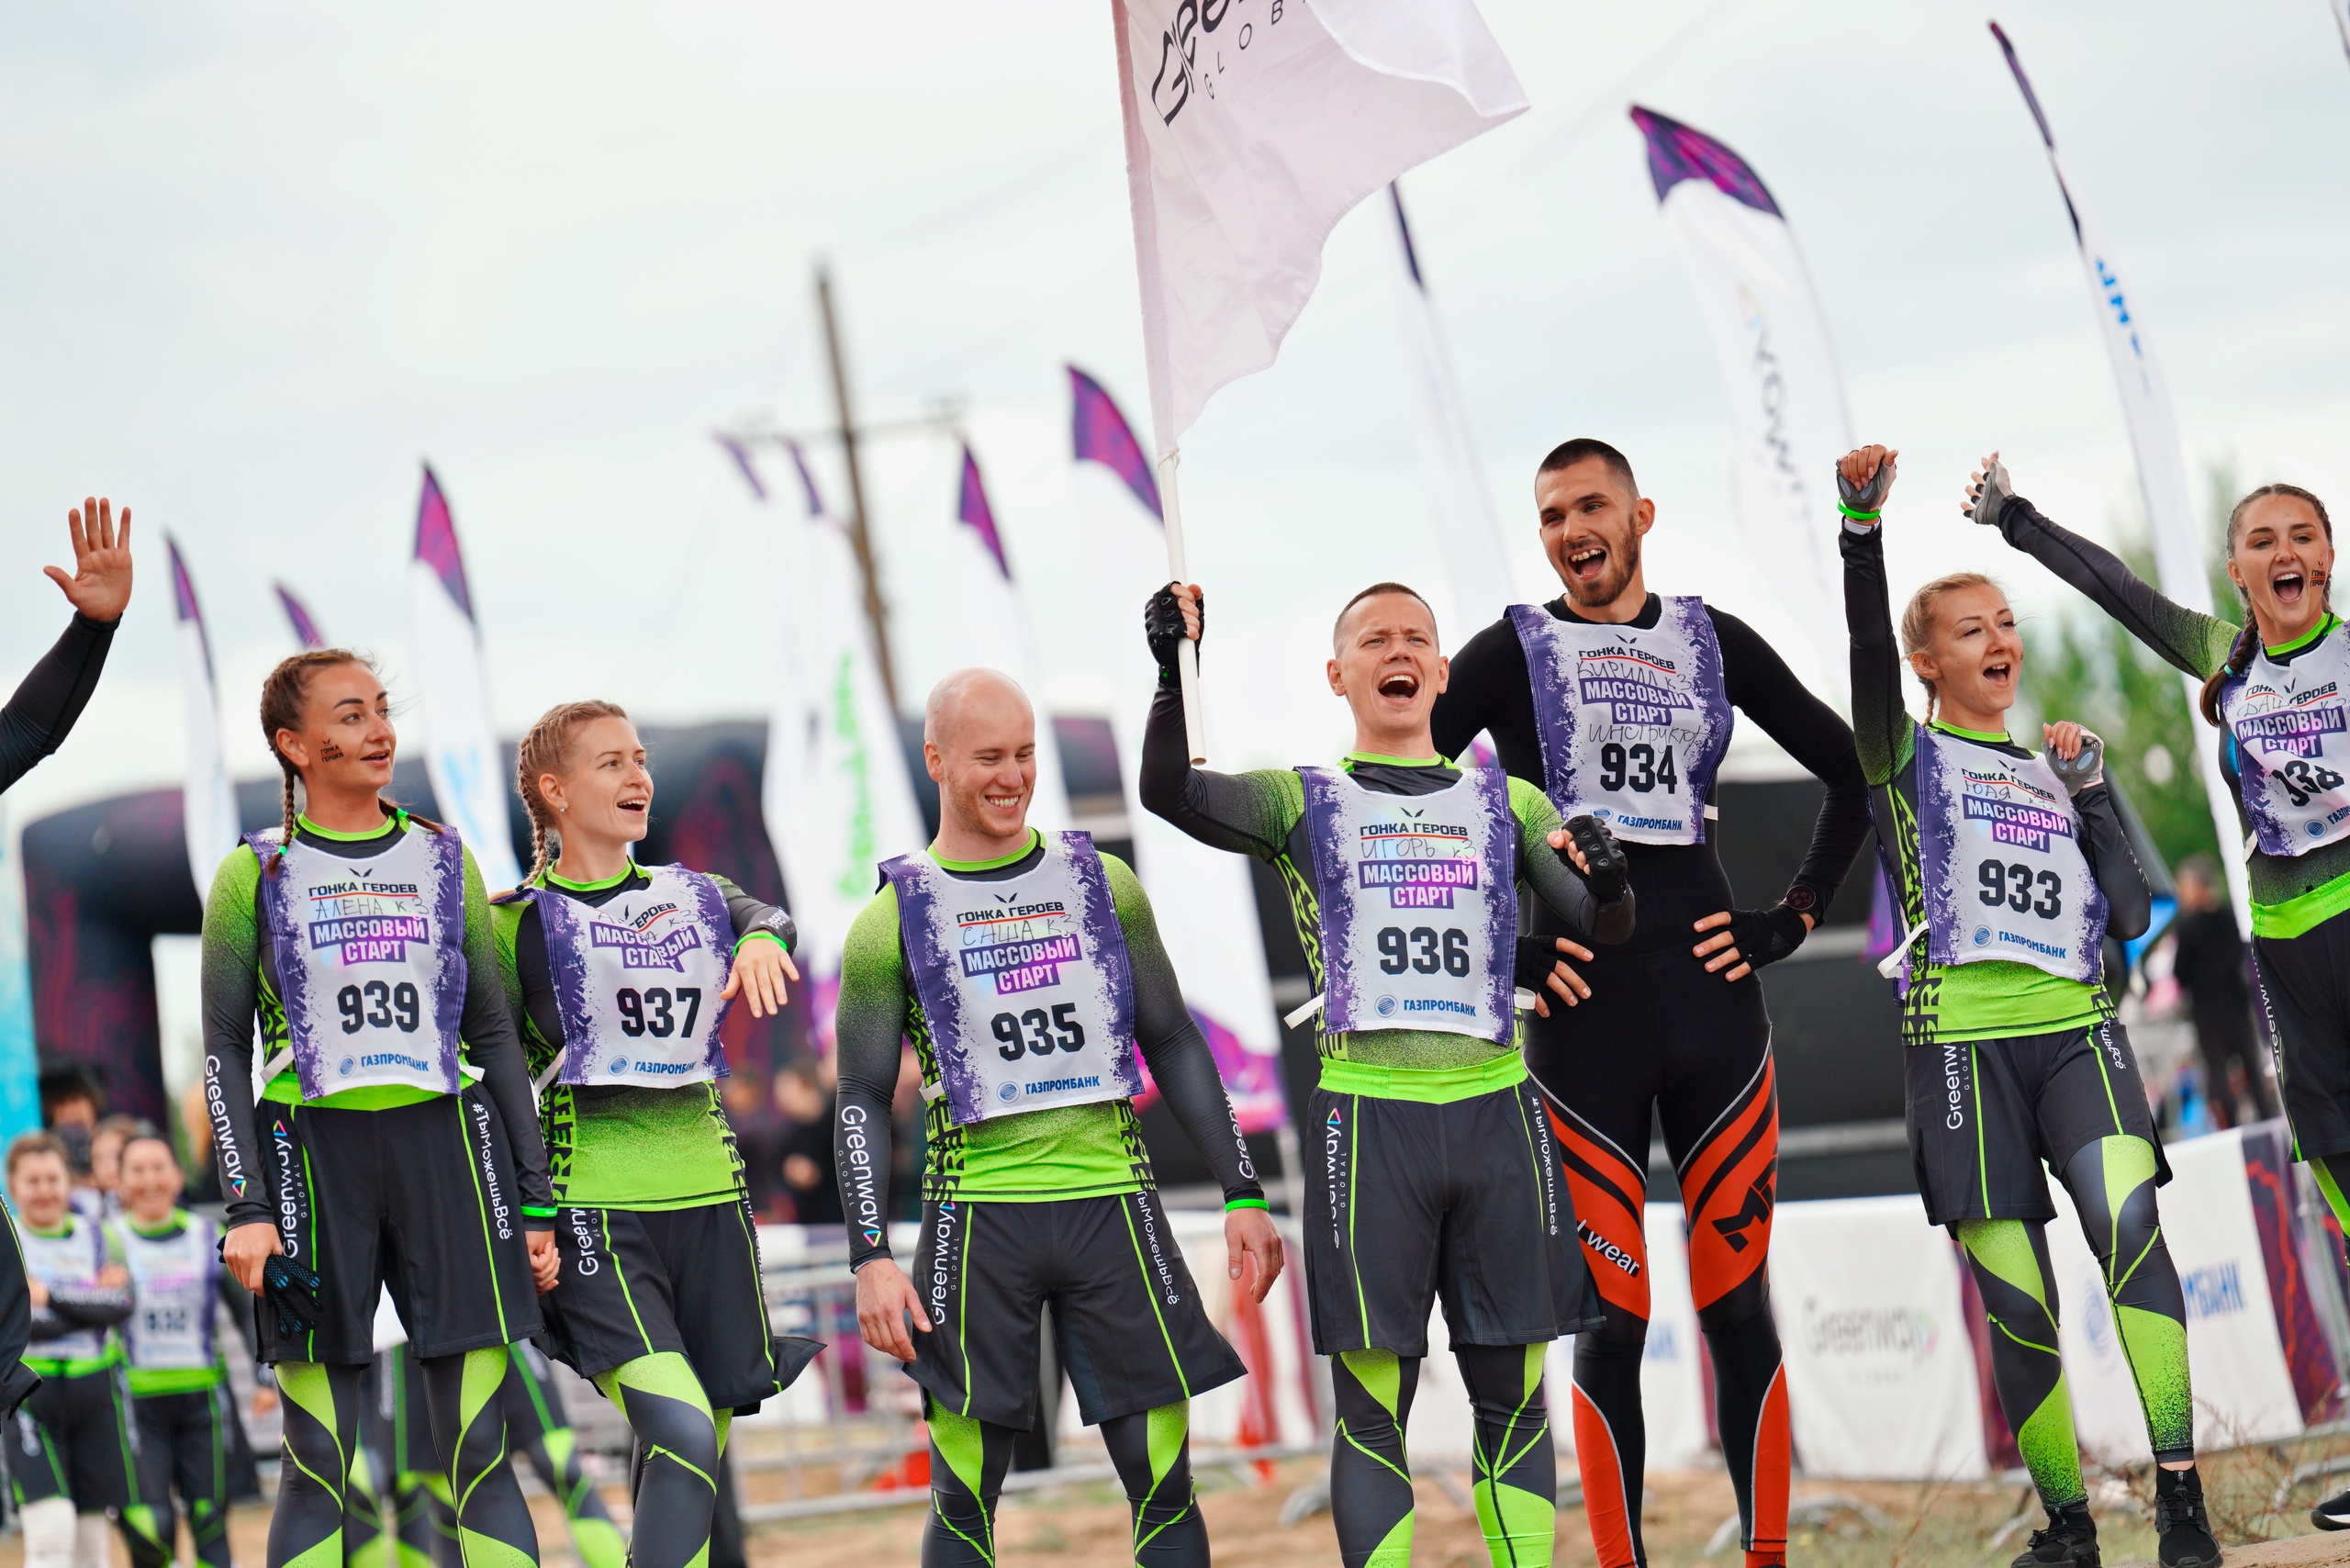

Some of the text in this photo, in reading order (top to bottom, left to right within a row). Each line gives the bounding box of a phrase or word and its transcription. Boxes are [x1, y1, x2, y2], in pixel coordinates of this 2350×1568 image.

[1579, 646, 1676, 670] ГОНКА ГЕРОЕВ
[1584, 681, 1689, 707] МАССОВЫЙ
[1615, 702, 1668, 723] СТАРТ
[2239, 708, 2342, 741] МАССОВЫЙ
[320, 745, 340, 755] ГОНКА
[321, 752, 344, 763] ГЕРОЕВ
[2265, 734, 2316, 756] СТАРТ
[1600, 743, 1678, 794] 934
[1962, 767, 2056, 801] ГОНКА ГЕРОЕВ
[1360, 823, 1468, 836] ГОНКА ГЕРОЕВ
[1617, 814, 1683, 831] ГАЗПРОМБАНК
[1967, 797, 2069, 834] МАССОВЫЙ
[1360, 837, 1436, 859] ИГОРЬ
[1996, 823, 2046, 849] СТАРТ
[1363, 857, 1474, 885] МАССОВЫЙ
[308, 881, 418, 897] ГОНКА ГЕРОЕВ
[1393, 886, 1449, 906] СТАРТ
[1978, 858, 2062, 920] 933
[316, 897, 384, 921] АЛЕНА
[956, 902, 1065, 924] ГОНКА ГЕРОЕВ
[314, 915, 426, 944] МАССОВЫЙ
[962, 919, 1035, 946] САША
[344, 939, 402, 962] СТАРТ
[965, 934, 1077, 972] МАССОВЫЙ
[1377, 926, 1471, 979] 936
[1998, 930, 2066, 959] ГАЗПРОМБАНК
[998, 964, 1055, 991] СТАРТ
[337, 980, 420, 1035] 939
[616, 988, 702, 1038] 937
[1404, 999, 1476, 1017] ГАЗПРОМБАНК
[990, 1002, 1086, 1062] 935
[361, 1053, 430, 1072] ГАЗПРОМБАНК
[1025, 1076, 1101, 1094] ГАЗПРОМБАНК
[205, 1055, 245, 1180] Greenway
[472, 1102, 513, 1240] #ТыМожешьВсё
[837, 1149, 856, 1207] GLOBAL
[841, 1104, 880, 1230] Greenway
[274, 1137, 299, 1259] Greenway
[294, 1163, 308, 1219] GLOBAL
[950, 1237, 959, 1291] GLOBAL
[1587, 1230, 1640, 1275] wear
[931, 1209, 956, 1326] Greenway
